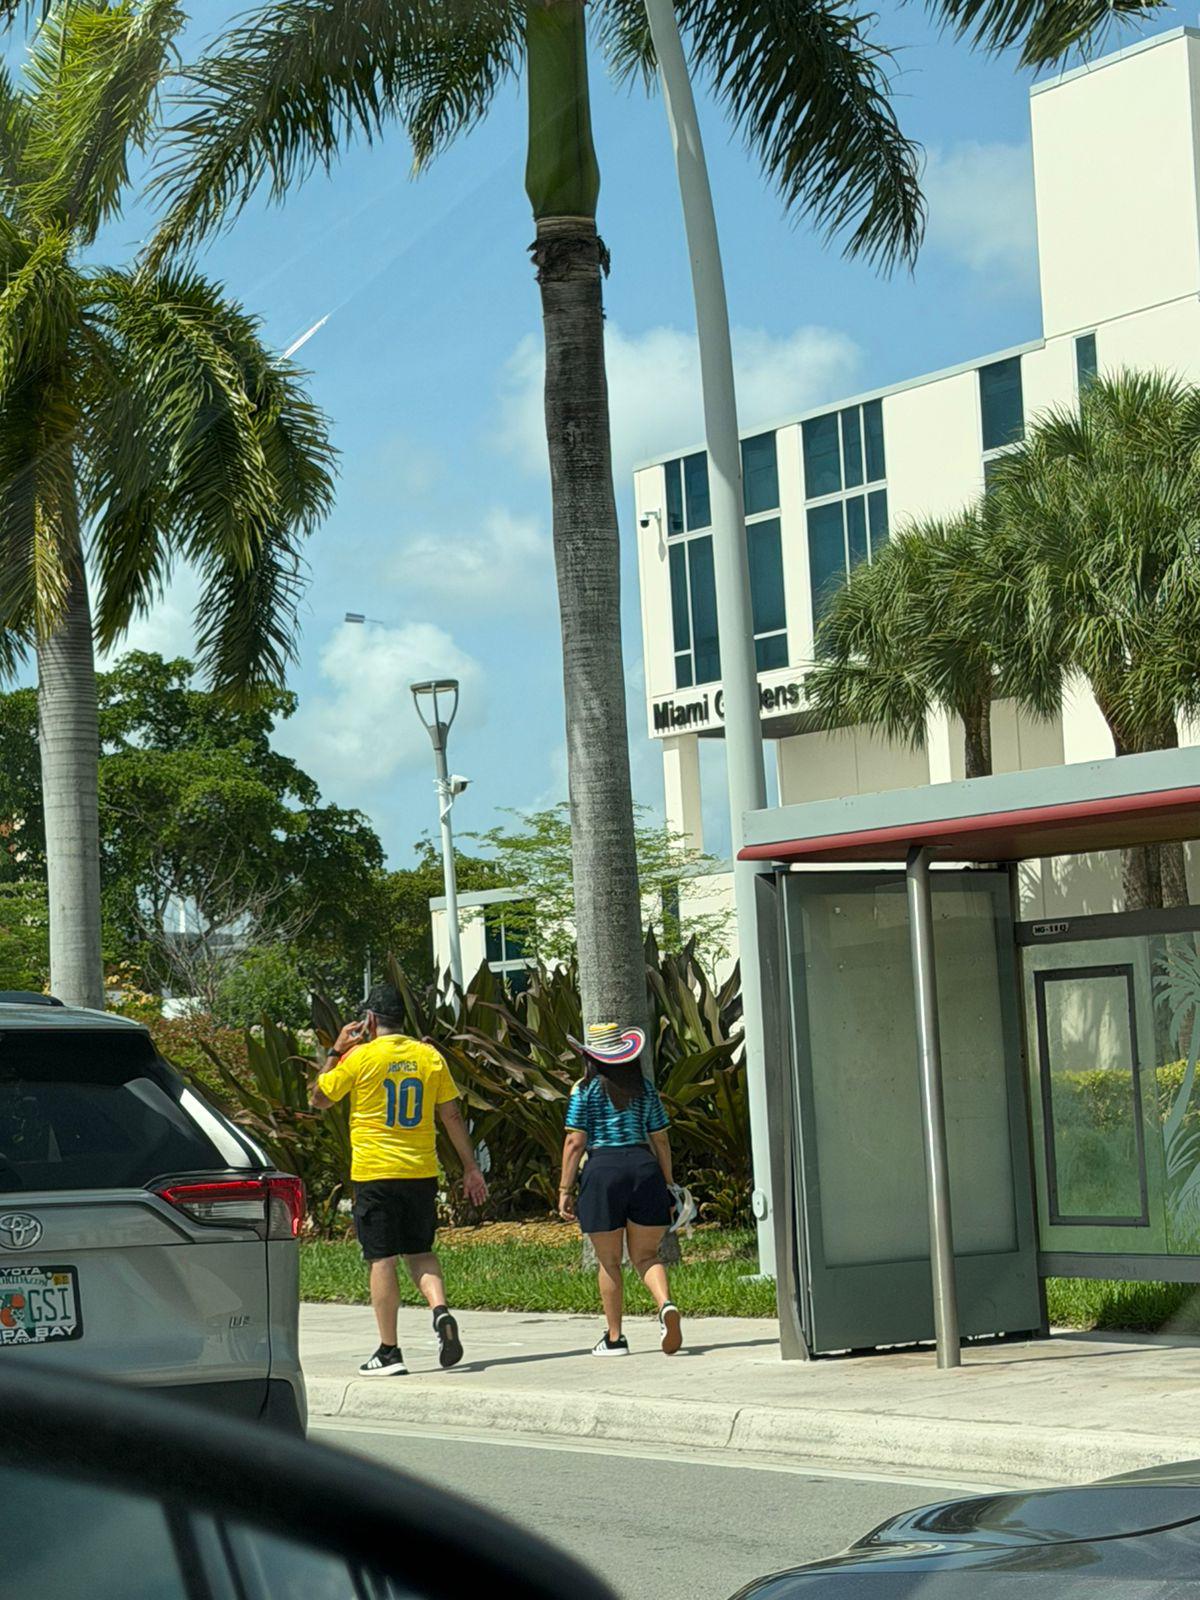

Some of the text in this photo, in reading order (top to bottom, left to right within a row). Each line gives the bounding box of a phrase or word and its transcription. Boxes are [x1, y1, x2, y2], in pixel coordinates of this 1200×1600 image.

[653, 693, 710, 730] Miami
[714, 682, 800, 718] Gens
[383, 1077, 424, 1128] 10
[28, 1288, 71, 1323] GSI
[0, 1325, 76, 1342] PA BAY
